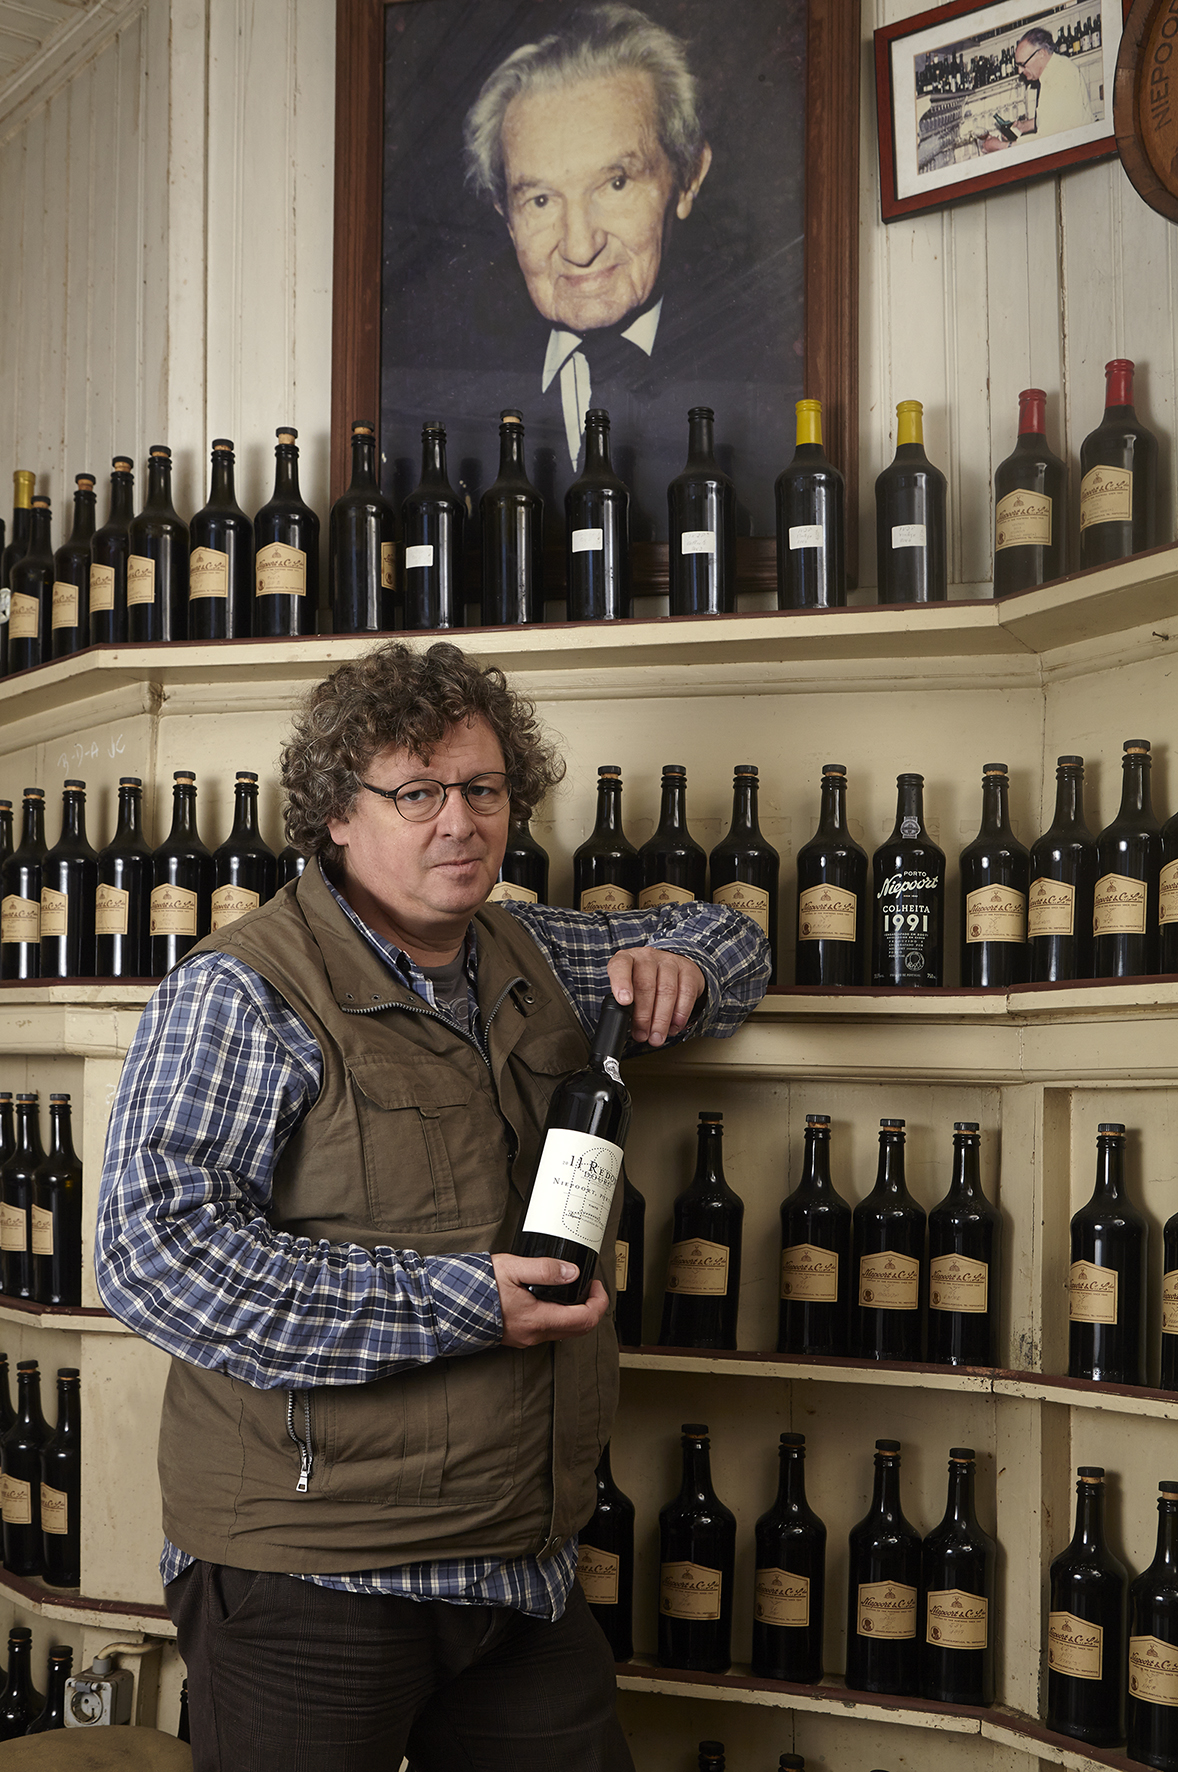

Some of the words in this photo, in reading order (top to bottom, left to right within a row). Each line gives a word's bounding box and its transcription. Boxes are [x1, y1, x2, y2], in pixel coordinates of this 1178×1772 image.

[877, 874, 939, 899] Niepoort
[882, 905, 930, 914] COLHEITA
[884, 914, 928, 932] 1991
